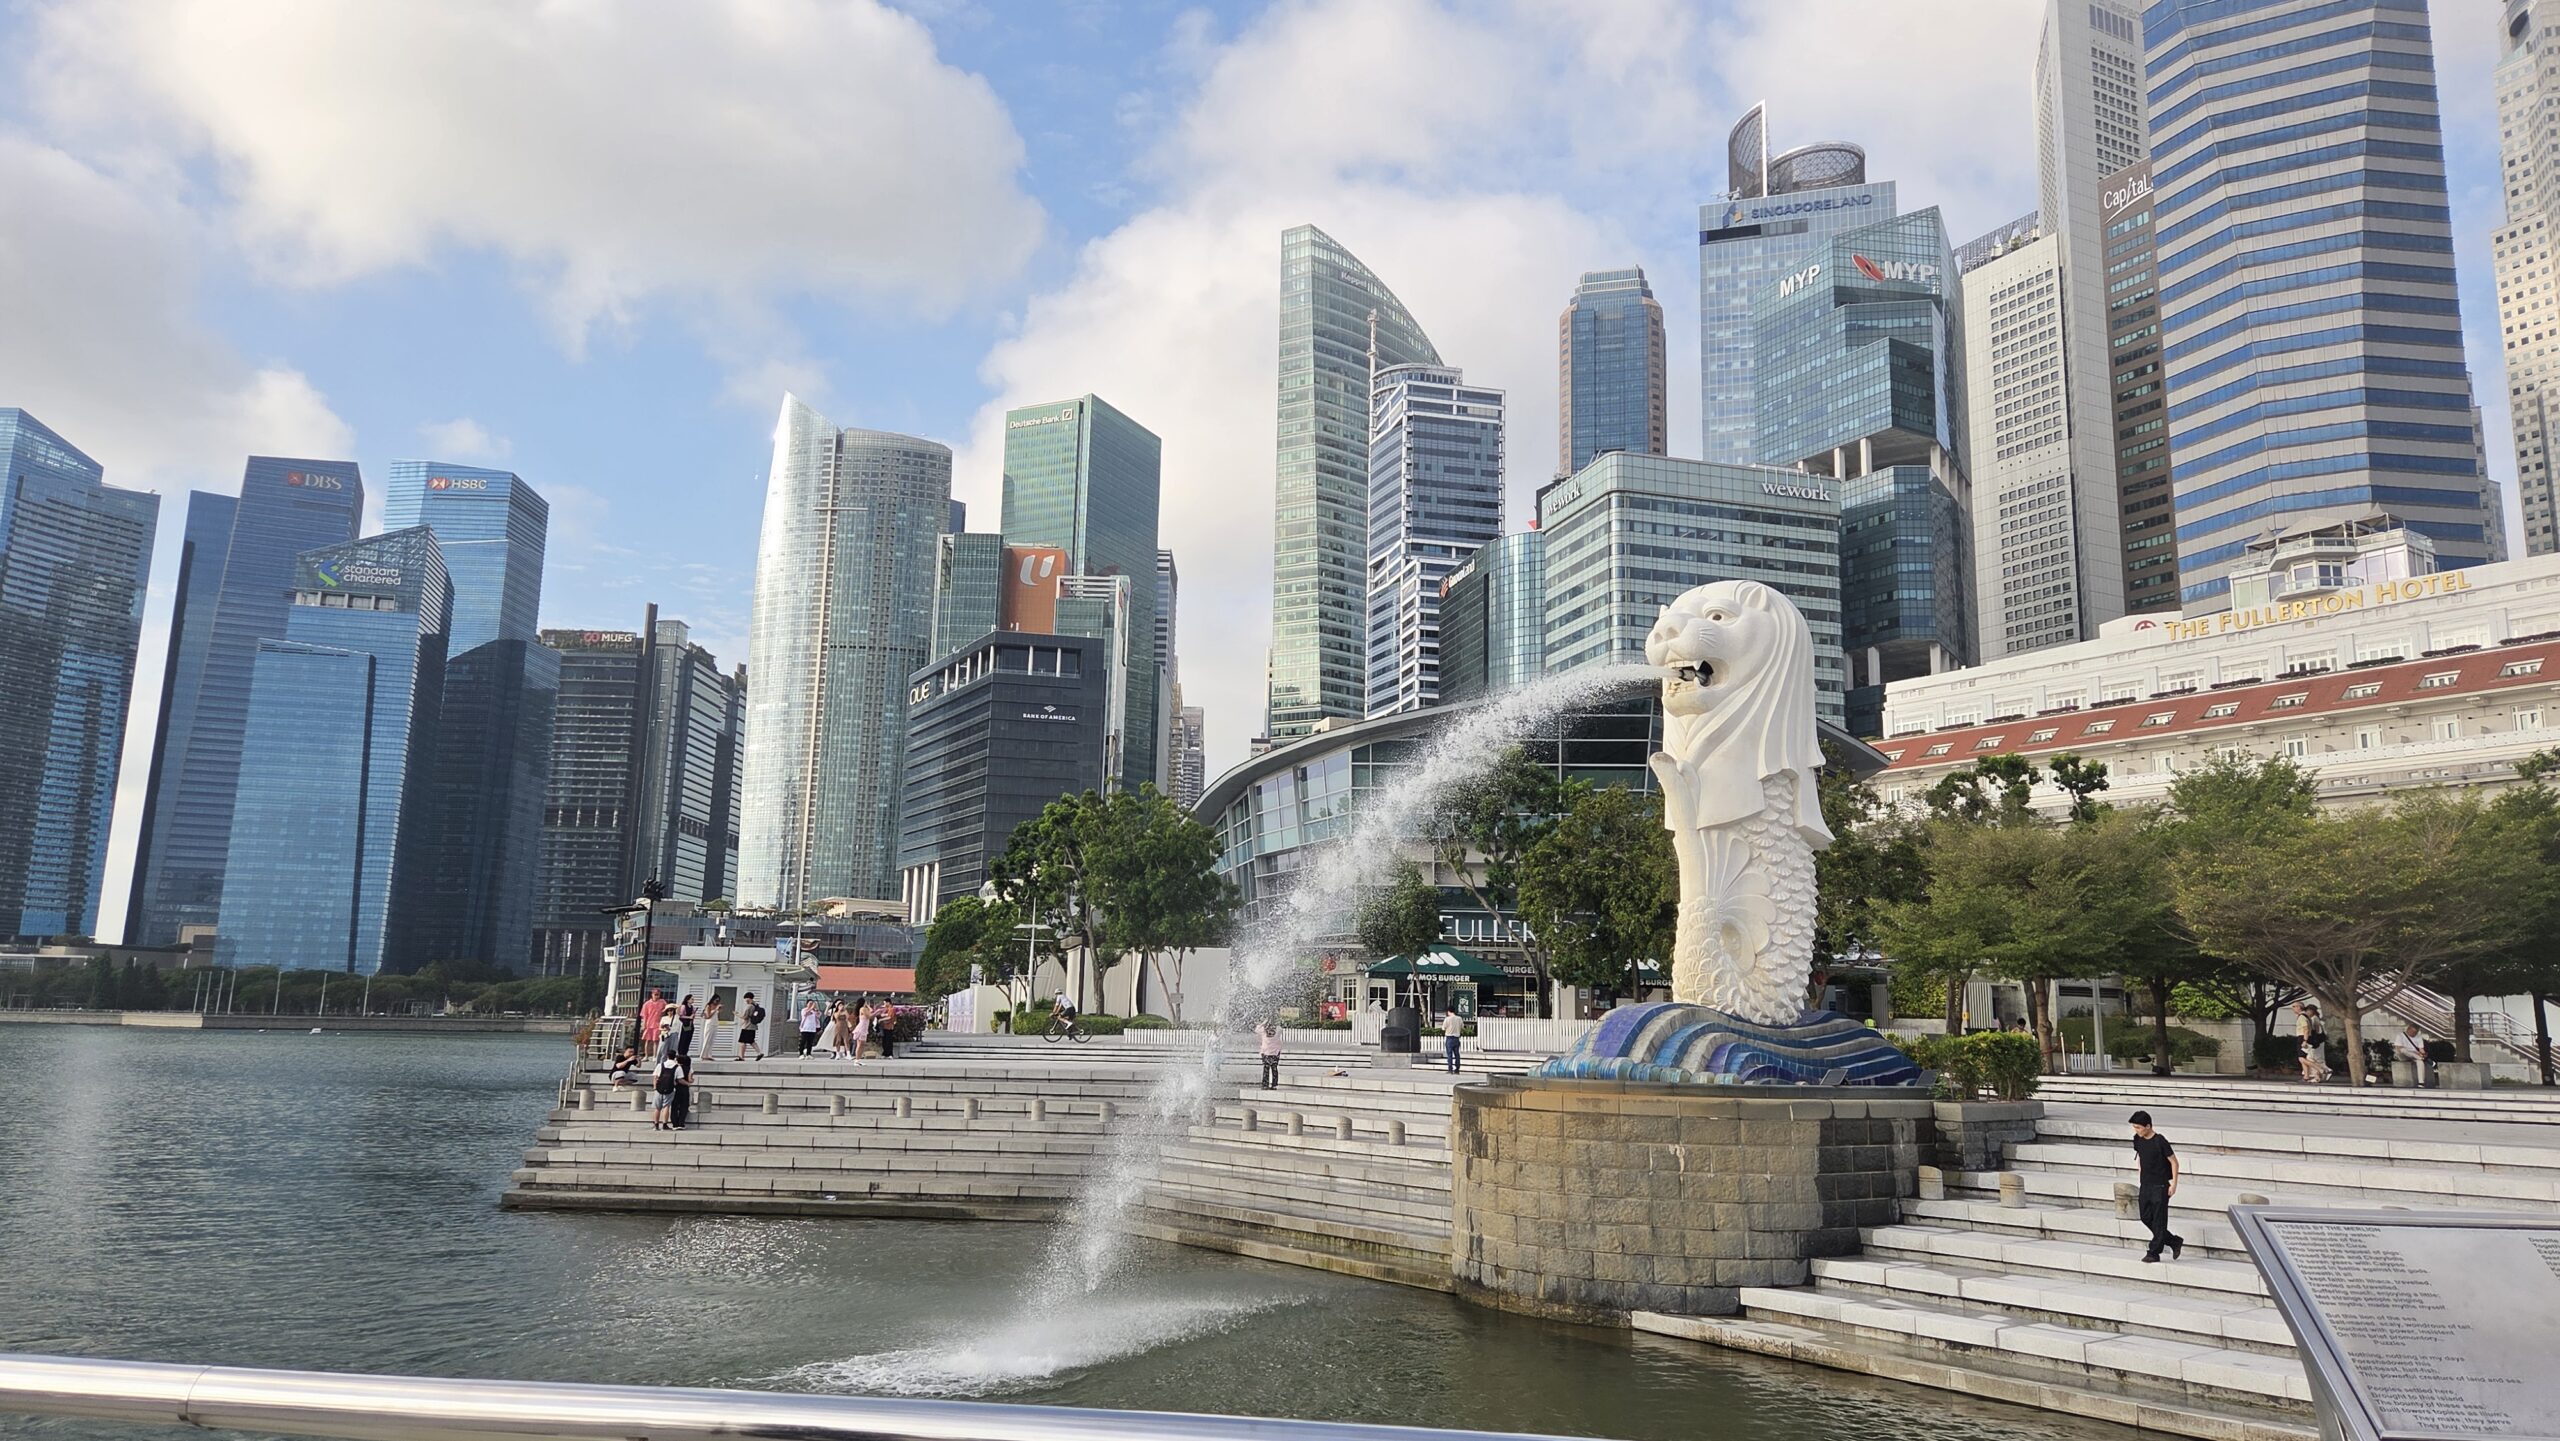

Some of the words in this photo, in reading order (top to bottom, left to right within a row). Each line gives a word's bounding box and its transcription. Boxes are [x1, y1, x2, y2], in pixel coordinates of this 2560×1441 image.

[2103, 173, 2154, 209] CapitaL
[1751, 194, 1873, 220] SINGAPORELAND
[1884, 261, 1934, 282] MYP
[1780, 264, 1821, 298] MYP
[1009, 418, 1042, 429] Deutsche
[1042, 415, 1061, 424] Bank
[305, 473, 342, 490] DBS
[451, 479, 488, 490] HSBC
[1546, 480, 1582, 516] wework
[1761, 483, 1831, 501] wework
[344, 563, 399, 577] standard
[343, 573, 402, 586] chartered
[2165, 619, 2210, 641] THE
[2219, 589, 2364, 633] FULLERTON
[2375, 570, 2472, 604] HOTEL
[601, 633, 633, 643] MUFG
[909, 681, 931, 706] OUE
[1418, 973, 1438, 981] MOS
[1438, 974, 1470, 982] BURGER
[1502, 965, 1535, 974] BURGE
